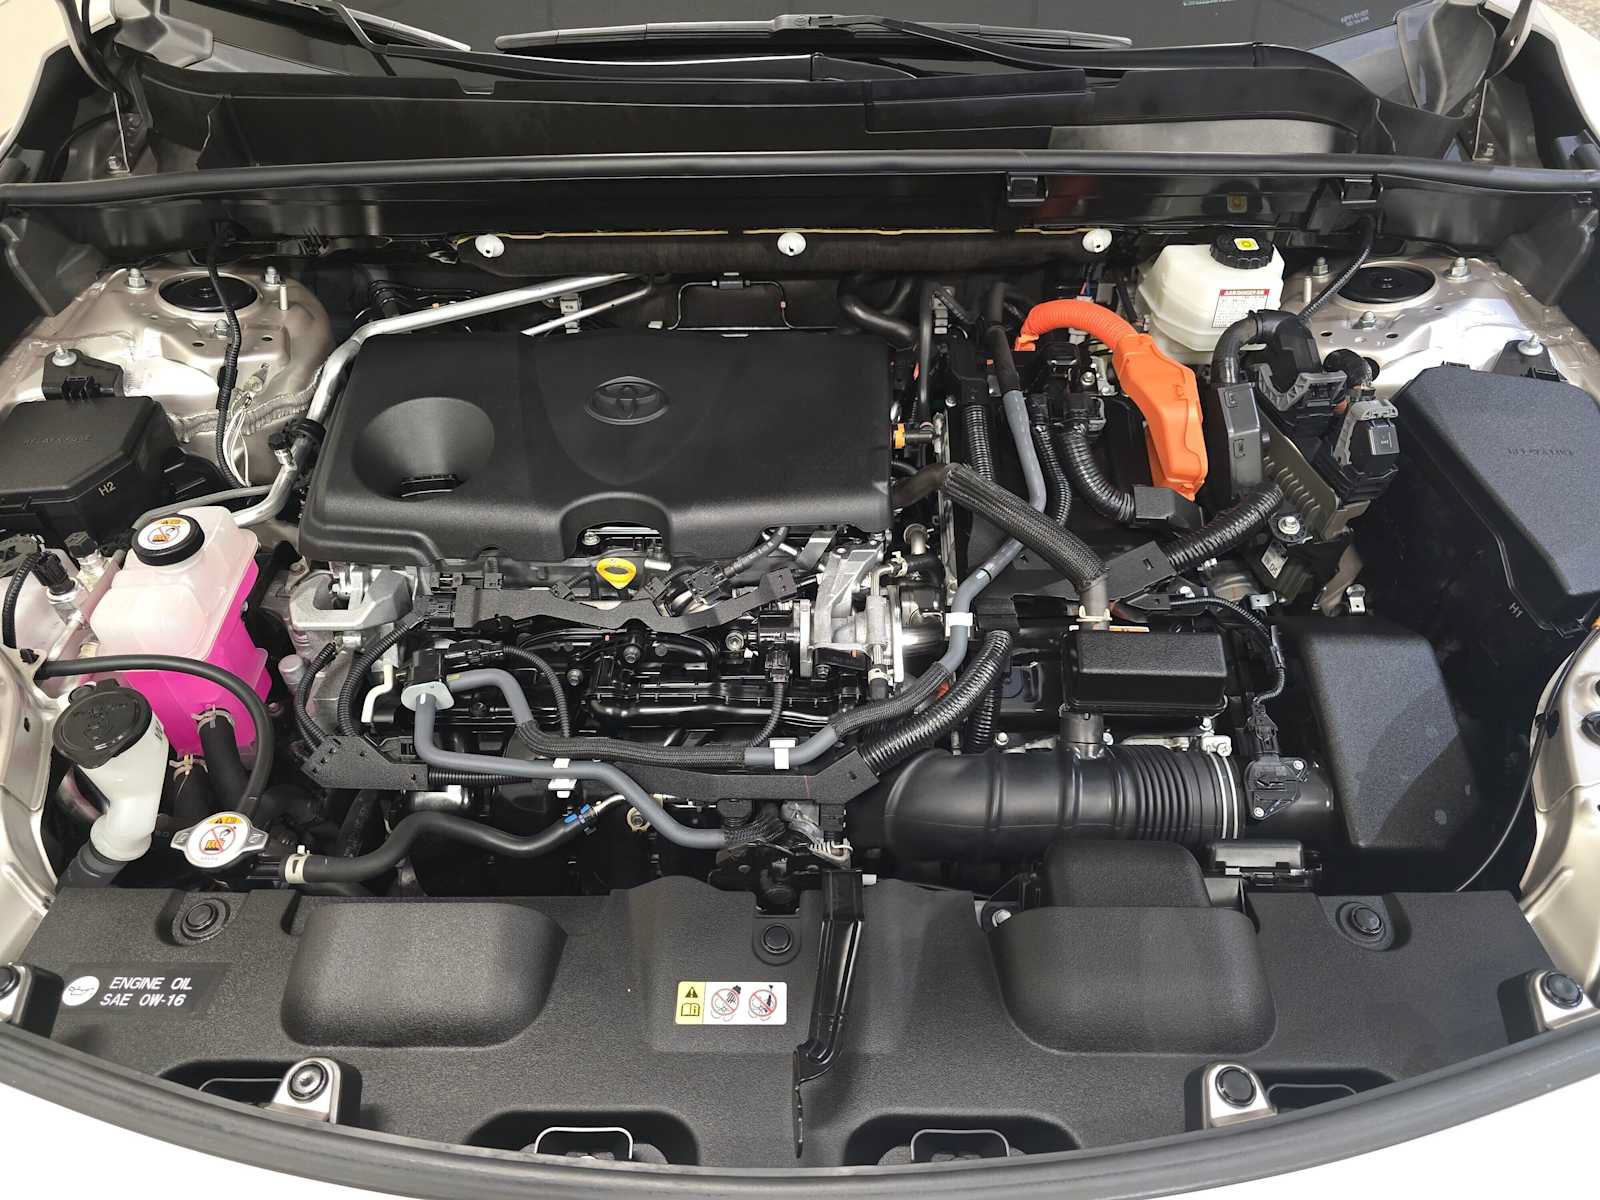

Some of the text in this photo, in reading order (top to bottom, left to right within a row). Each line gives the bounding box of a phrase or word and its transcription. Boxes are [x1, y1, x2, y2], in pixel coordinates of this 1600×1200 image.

[98, 481, 117, 497] H2
[109, 976, 193, 991] ENGINE OIL
[100, 993, 133, 1006] SAE
